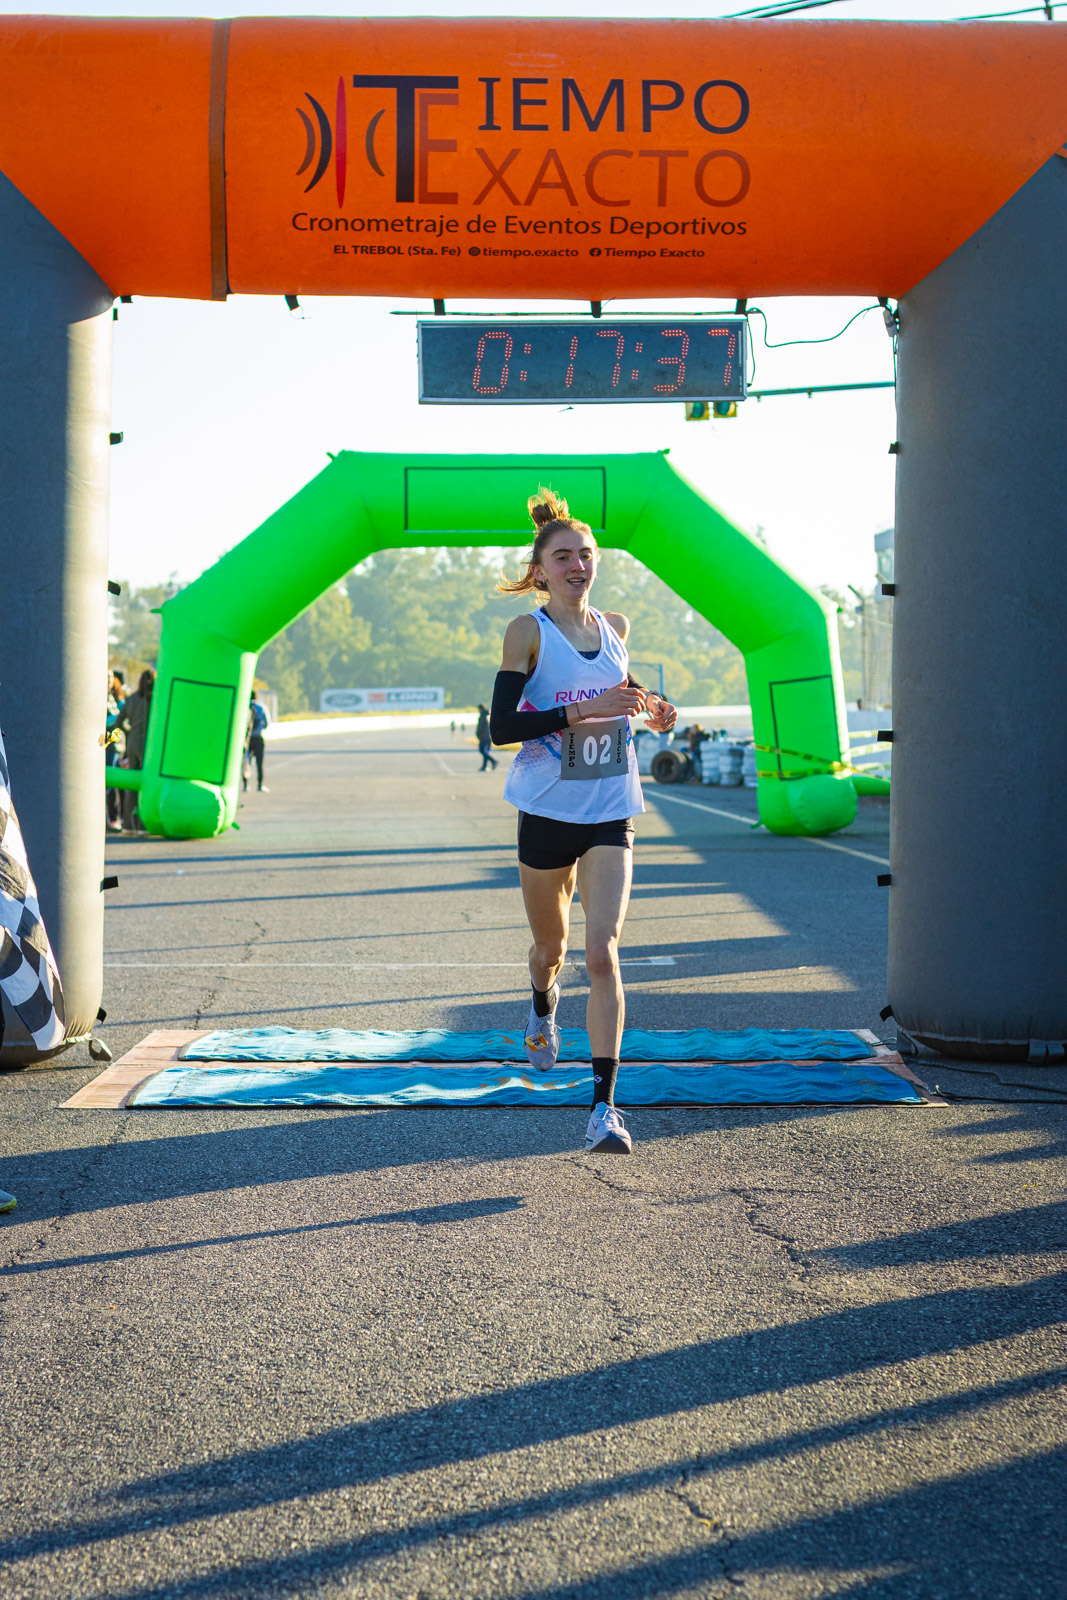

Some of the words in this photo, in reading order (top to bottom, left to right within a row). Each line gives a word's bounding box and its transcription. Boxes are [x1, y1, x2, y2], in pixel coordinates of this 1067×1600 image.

[418, 93, 751, 208] EXACTO
[292, 212, 459, 237] Cronometraje
[466, 214, 497, 233] de
[504, 215, 602, 235] Eventos
[609, 216, 748, 239] Deportivos
[333, 244, 350, 255] EL
[351, 244, 405, 256] TREBOL
[408, 245, 439, 256] (Sta.
[441, 246, 462, 257] Fe)
[483, 246, 579, 259] tiempo.exacto
[604, 247, 657, 259] Tiempo
[660, 248, 706, 258] Exacto
[556, 688, 609, 703] RUNN
[583, 734, 612, 766] 02
